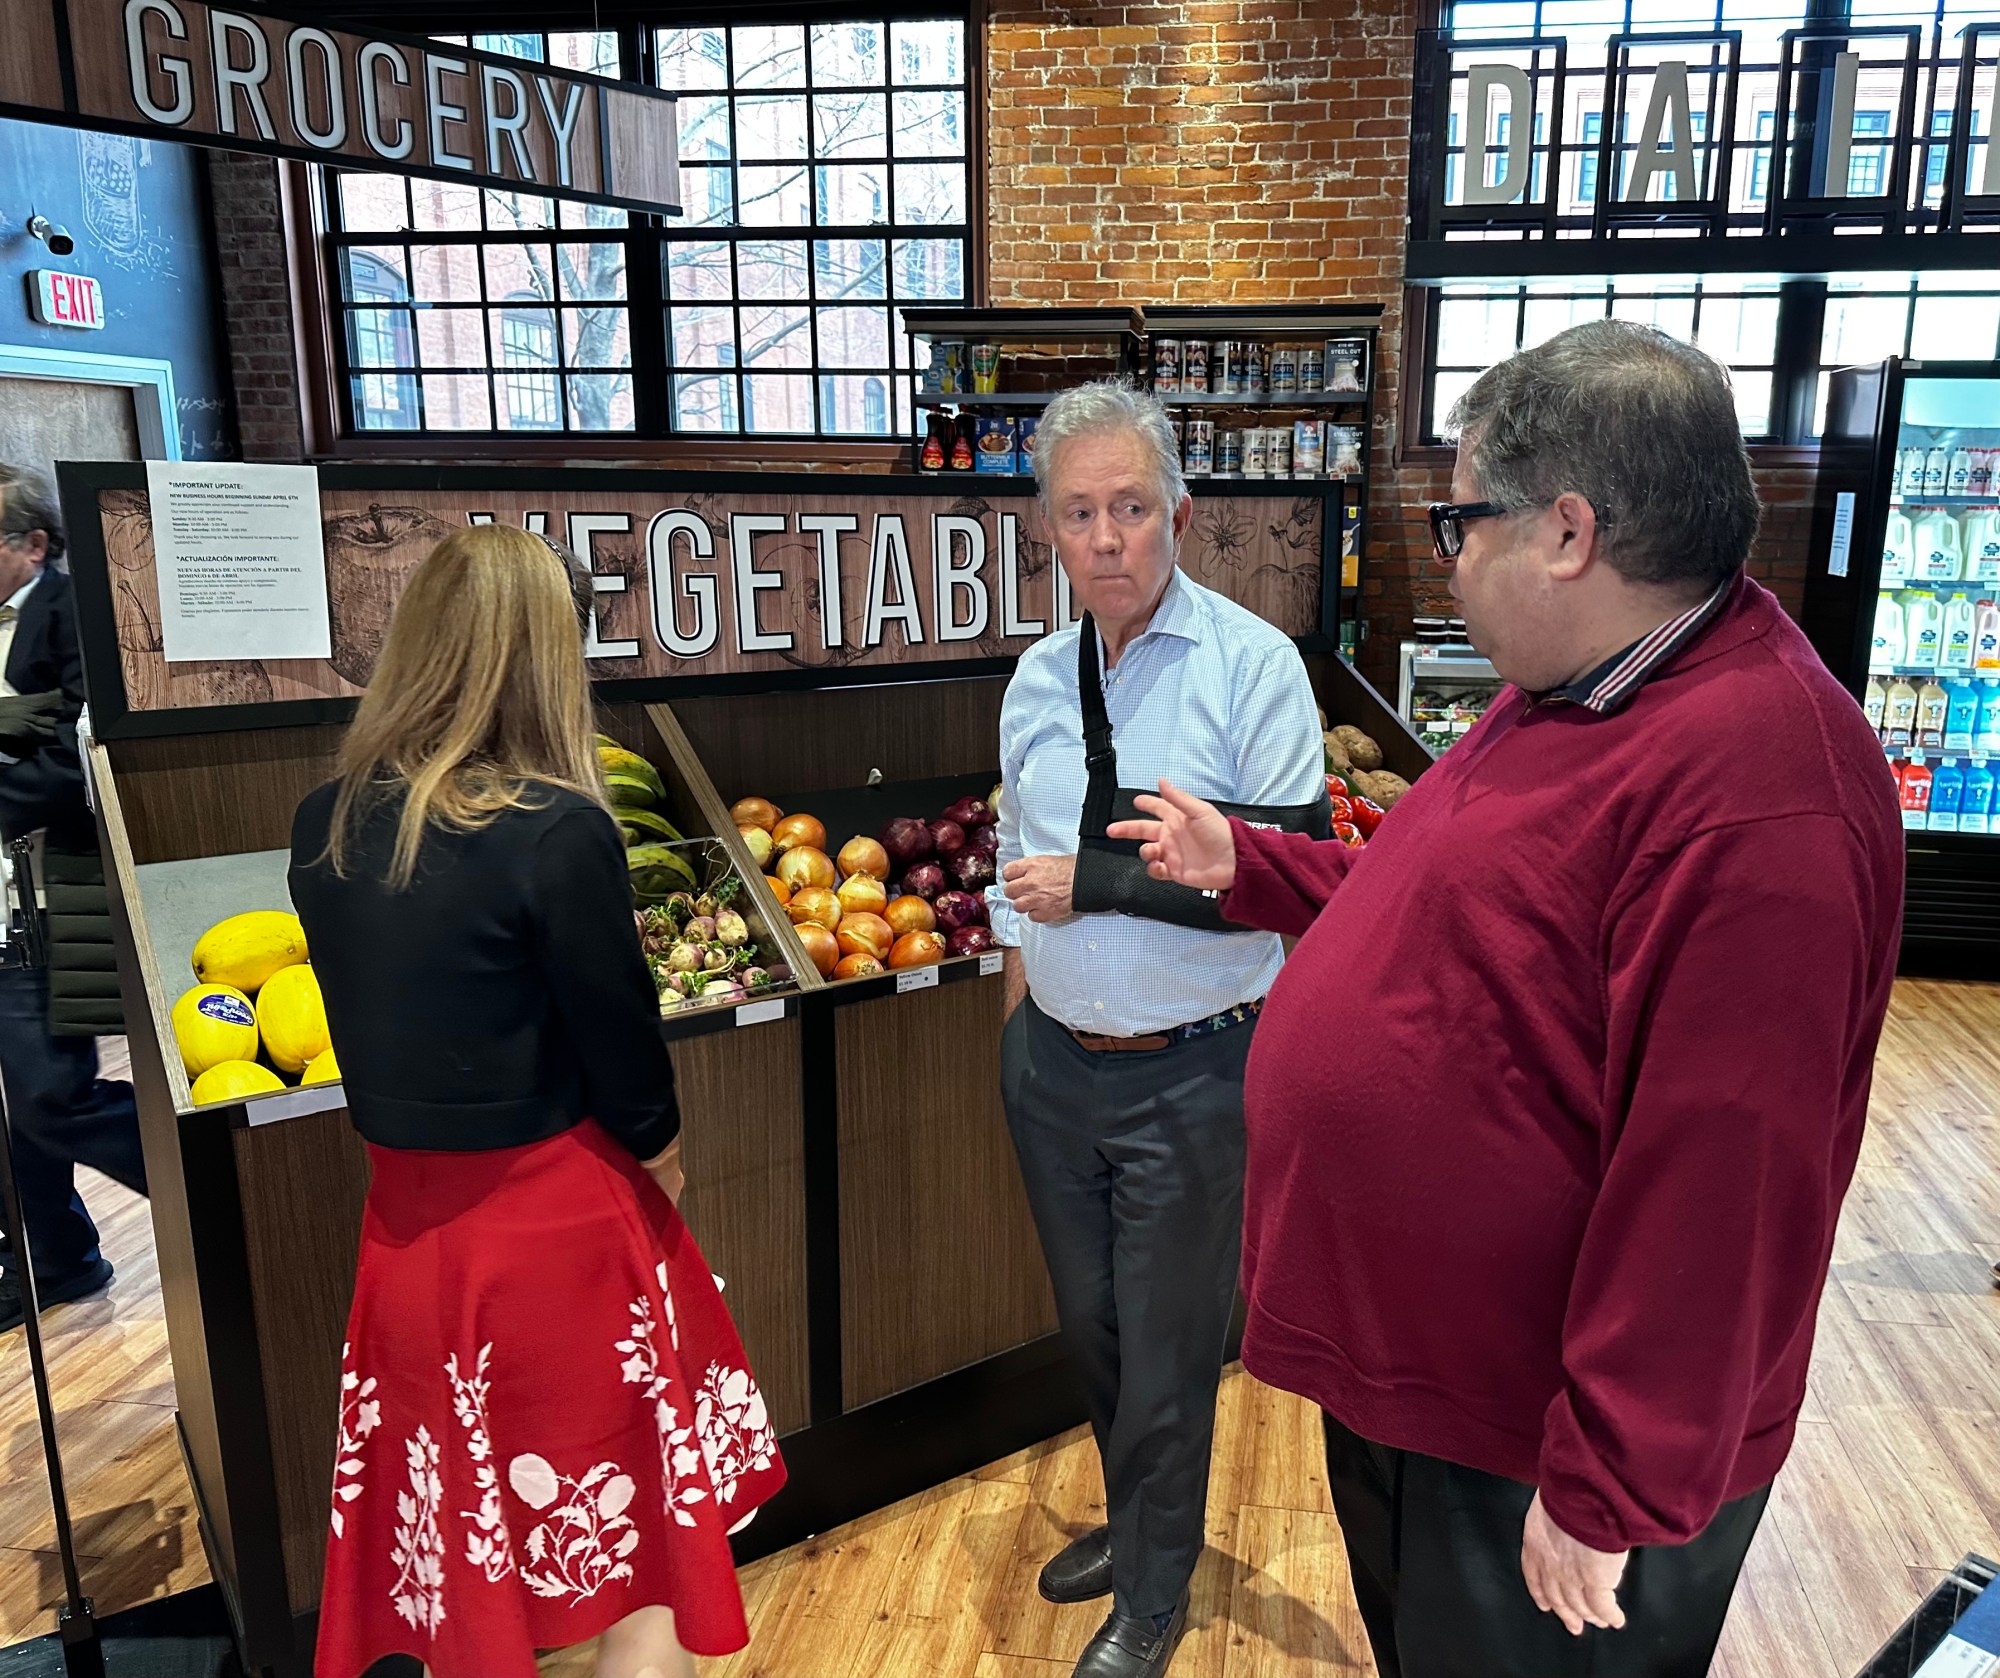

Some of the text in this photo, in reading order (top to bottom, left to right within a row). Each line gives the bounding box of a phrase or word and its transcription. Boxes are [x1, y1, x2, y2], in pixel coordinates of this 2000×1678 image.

[122, 0, 586, 188] GROCERY
[1462, 48, 2000, 206] DAI
[51, 273, 96, 325] EXIT
[466, 507, 1082, 660] EGETABL
